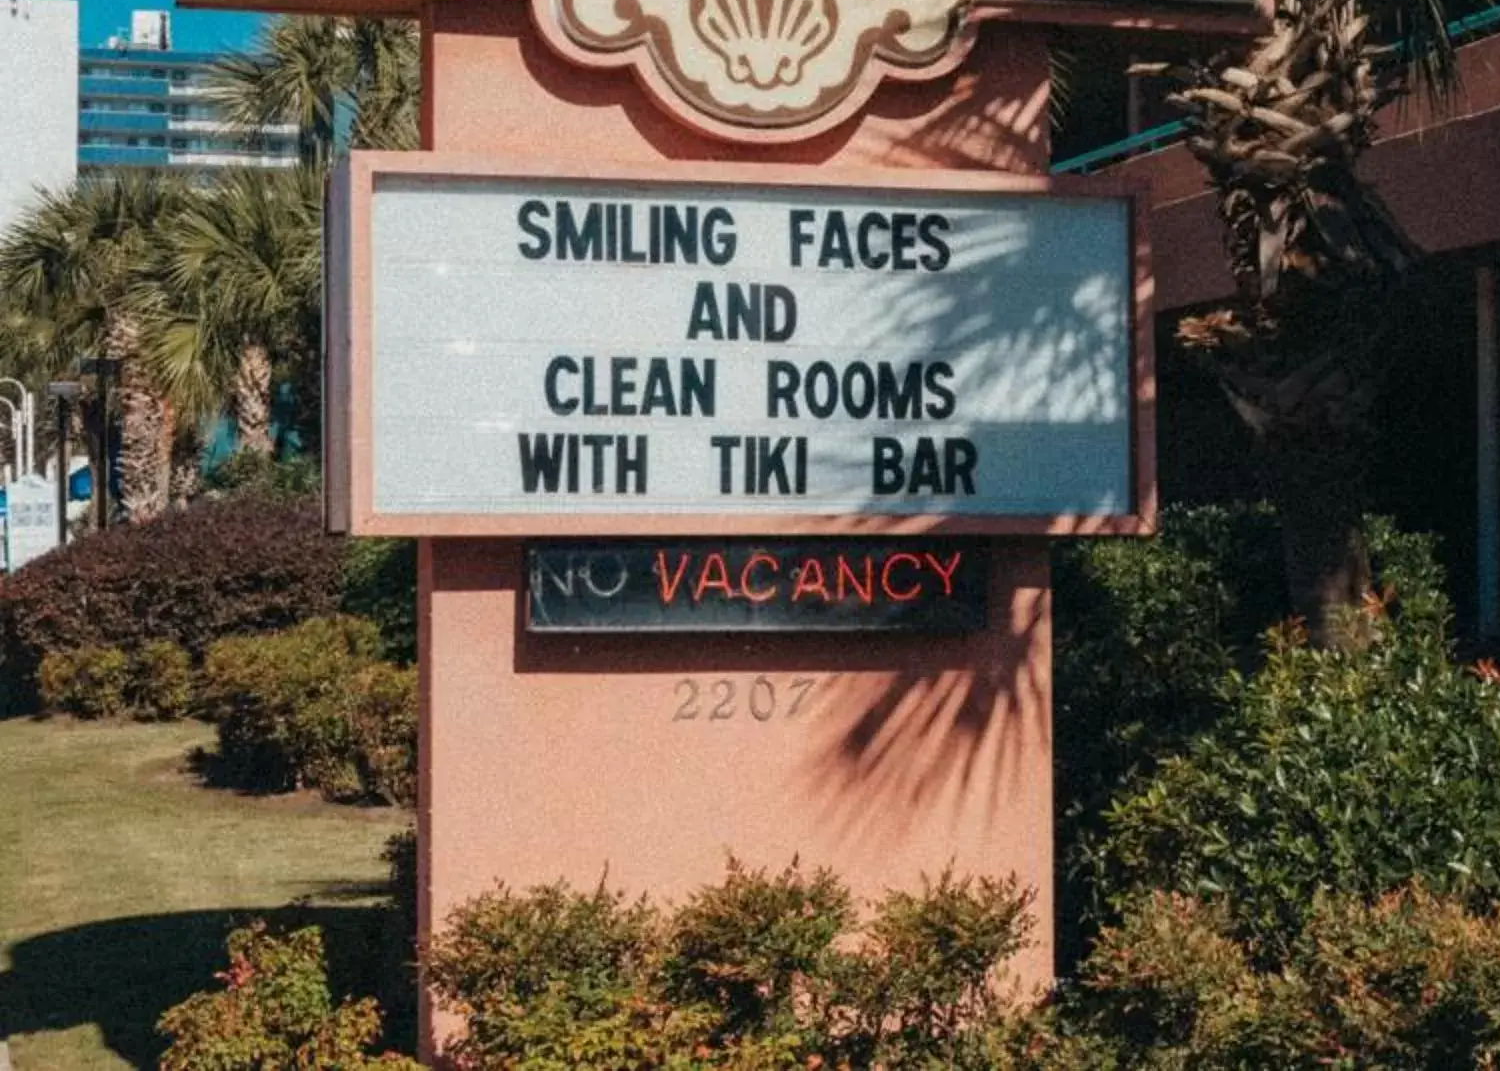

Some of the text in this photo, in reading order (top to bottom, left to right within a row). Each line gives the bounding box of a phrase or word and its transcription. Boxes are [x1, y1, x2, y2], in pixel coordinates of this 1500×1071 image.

[518, 200, 952, 272] SMILING FACES
[686, 282, 798, 344] AND
[544, 356, 956, 421] CLEAN ROOMS
[518, 433, 977, 496] WITH TIKI BAR
[531, 549, 961, 603] NO VACANCY
[671, 676, 816, 722] 2207
